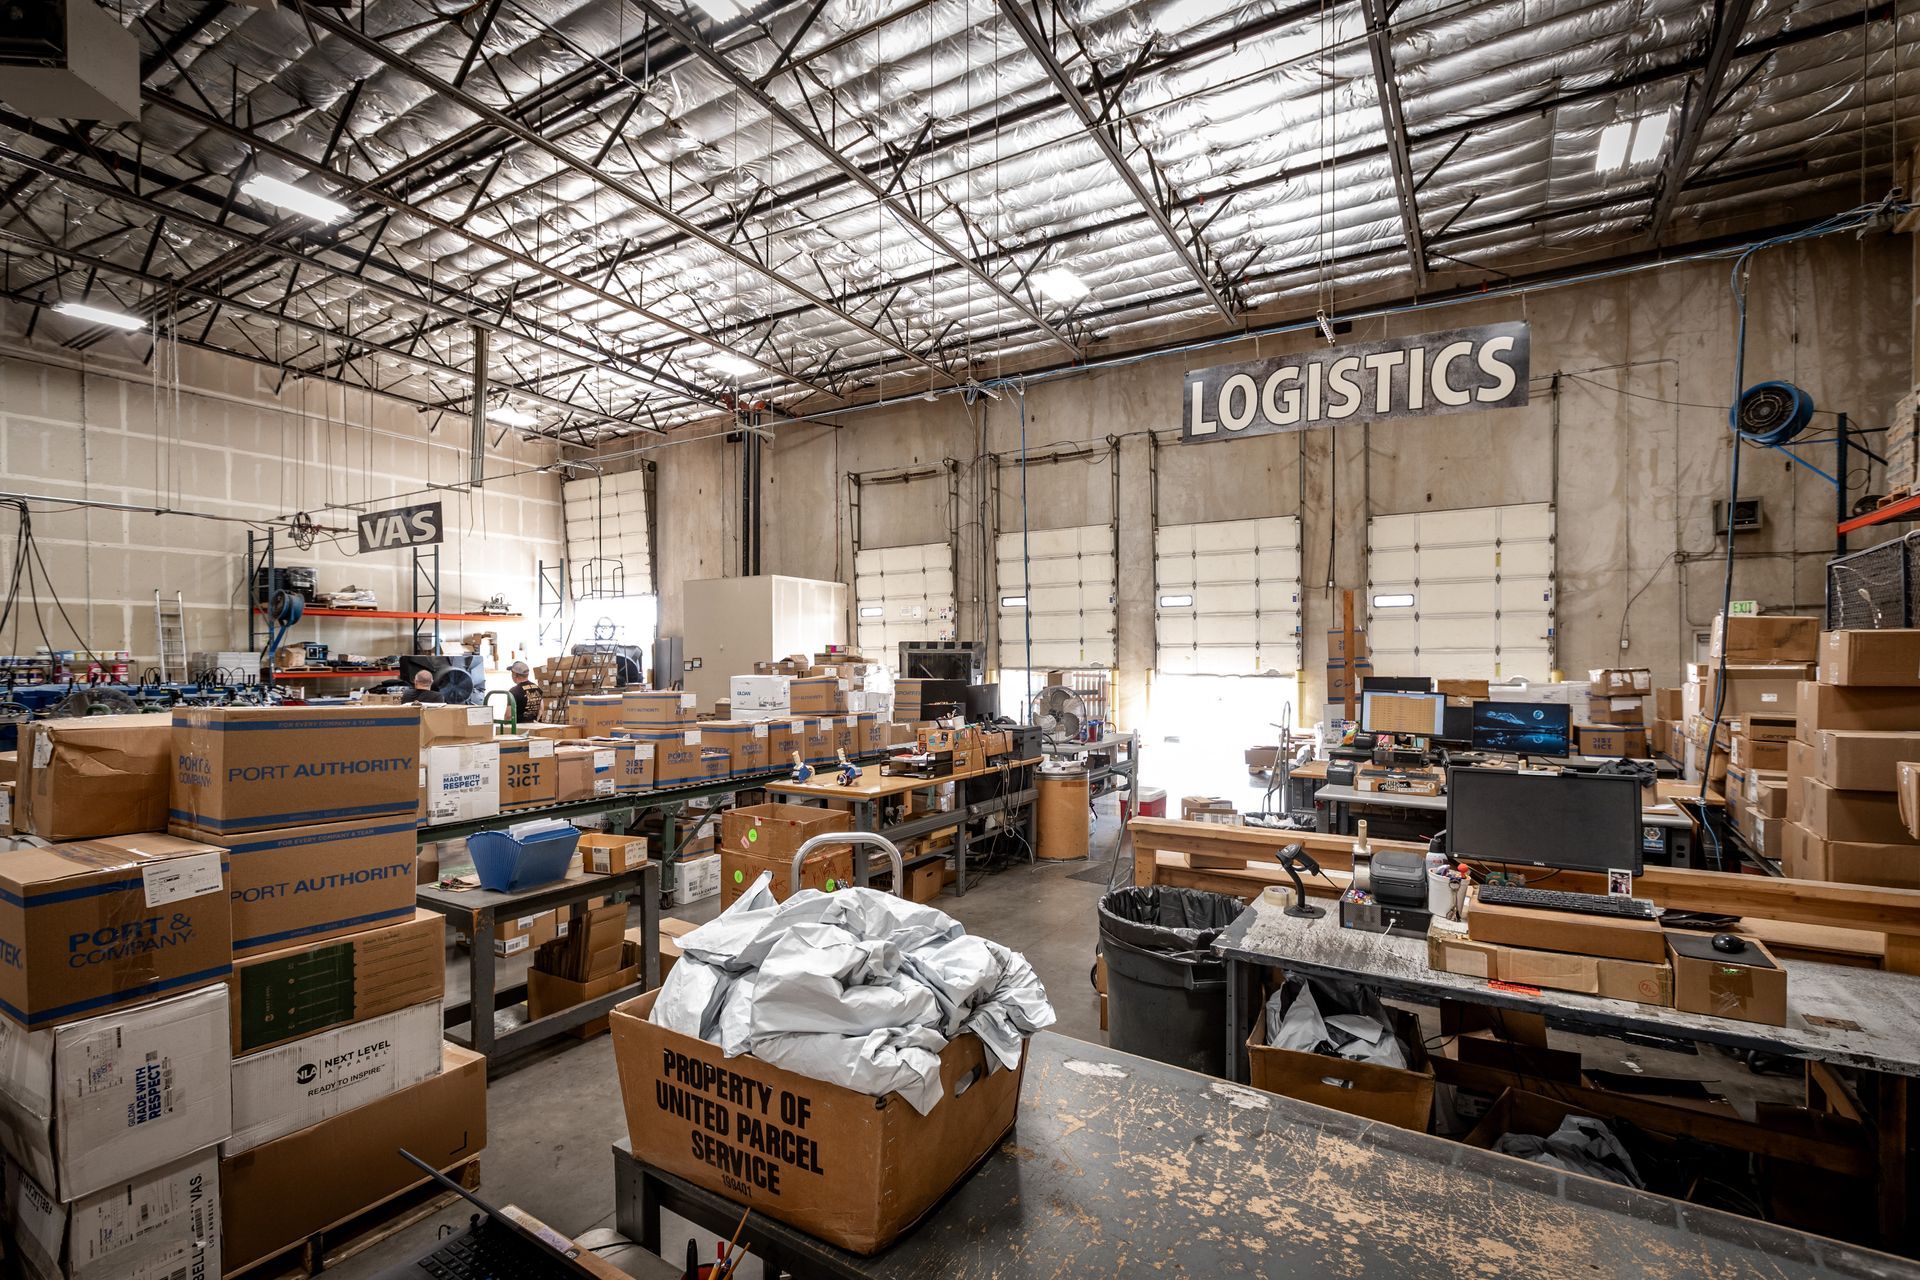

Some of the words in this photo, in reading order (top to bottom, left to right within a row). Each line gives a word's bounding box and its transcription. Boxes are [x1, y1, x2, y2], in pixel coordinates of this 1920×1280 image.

[1190, 335, 1517, 437] LOGISTICS
[361, 509, 437, 549] VAS
[1733, 601, 1753, 614] EXIT
[179, 755, 204, 772] PORT
[204, 758, 212, 774] &
[228, 764, 290, 782] PORT
[293, 757, 413, 778] AUTHORITY
[443, 775, 463, 784] MADE
[463, 773, 481, 782] WITH
[507, 762, 540, 775] DIST
[179, 773, 211, 788] COMPANY
[443, 779, 480, 790] RESPECT
[507, 774, 541, 788] RICT
[231, 882, 290, 903] PORT
[293, 862, 412, 894] AUTHORITY
[69, 916, 164, 953] PORT
[170, 912, 193, 931] &
[68, 929, 193, 968] COMPANY
[324, 1051, 355, 1068] NEXT
[357, 1039, 391, 1057] LEVEL
[327, 1050, 388, 1074] APPAREL
[135, 1066, 147, 1095] WITH
[147, 1063, 162, 1121] RESPECT
[307, 1081, 336, 1097] READY
[336, 1077, 349, 1086] TO
[350, 1066, 382, 1083] INSPIRE
[663, 1047, 774, 1116] PROPERTY
[780, 1090, 812, 1130] OF
[128, 1103, 136, 1128] GILDAN
[137, 1095, 148, 1124] MADE
[655, 1079, 730, 1137] UNITED
[736, 1111, 825, 1177] PARCEL
[691, 1129, 781, 1196] SERVICE
[721, 1173, 752, 1199] 199401
